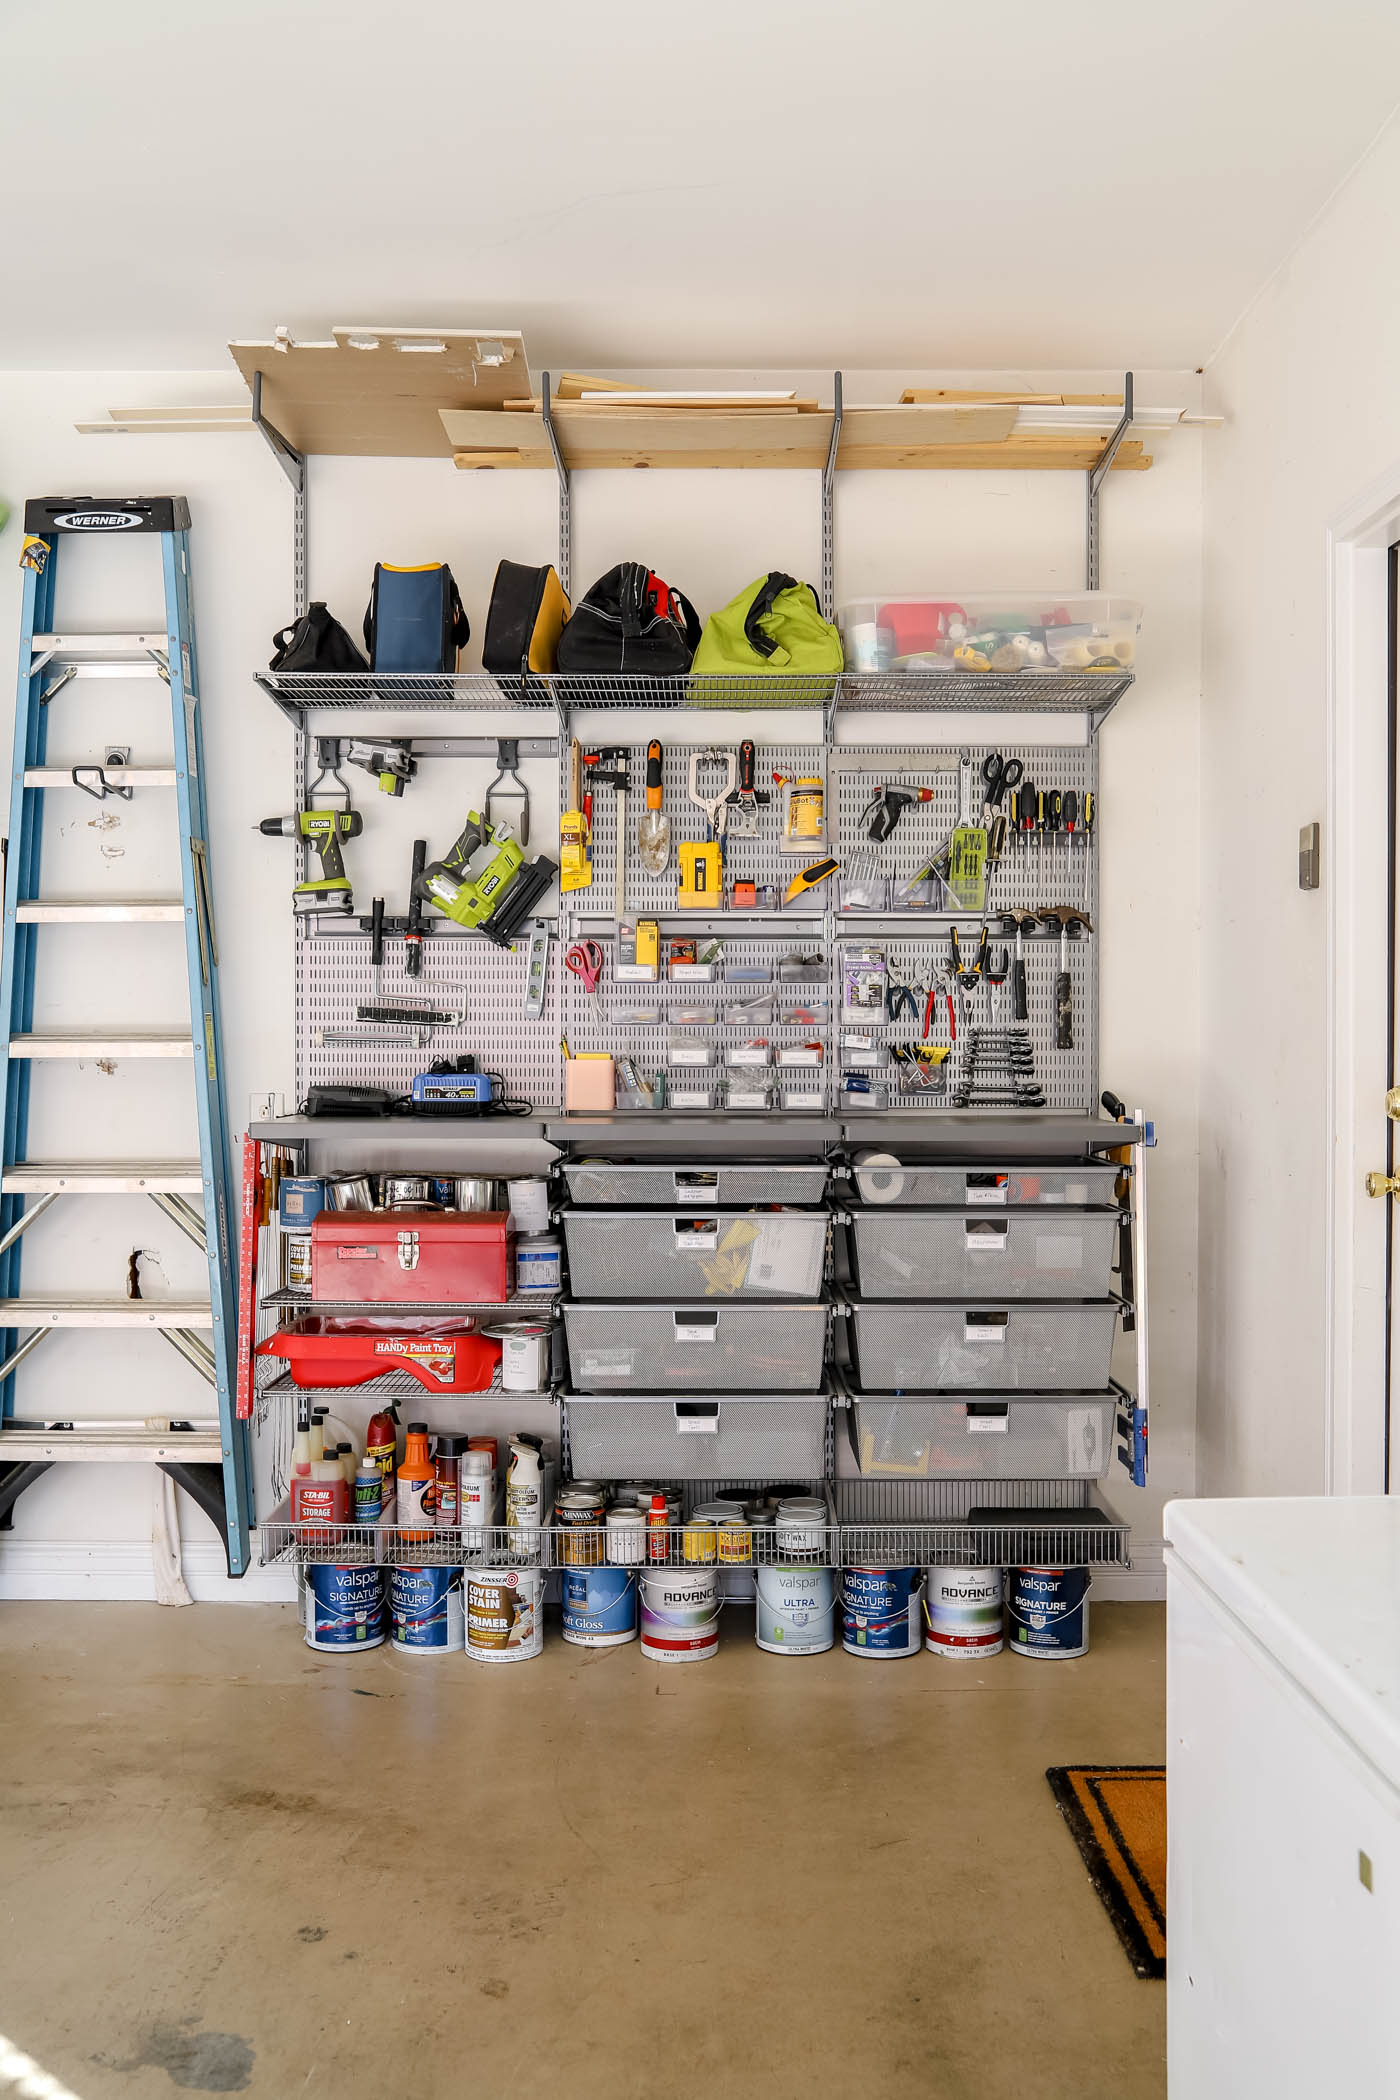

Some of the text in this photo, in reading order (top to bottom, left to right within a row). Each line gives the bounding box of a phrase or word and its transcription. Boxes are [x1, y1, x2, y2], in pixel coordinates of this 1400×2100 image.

[72, 516, 126, 525] WERNER
[482, 875, 500, 896] RYOBI
[220, 1202, 228, 1261] WERNER
[376, 1342, 452, 1354] HANDy Paint Tray
[302, 1507, 331, 1517] STORAGE
[563, 1511, 594, 1520] MINWAX
[335, 1570, 379, 1588] valspar
[391, 1571, 424, 1590] alspar
[779, 1575, 821, 1591] valspar
[844, 1574, 887, 1593] valspar
[1019, 1576, 1062, 1594] valspar
[329, 1585, 383, 1602] SIGNATURE
[469, 1584, 500, 1599] COVER
[664, 1585, 717, 1601] ADVANCE
[941, 1584, 999, 1599] ADVANCE
[469, 1595, 500, 1609] STAIN
[783, 1598, 816, 1607] ULTRA
[1014, 1595, 1067, 1611] SIGNATURE
[468, 1614, 509, 1628] PRIMER
[575, 1618, 604, 1630] Gloss
